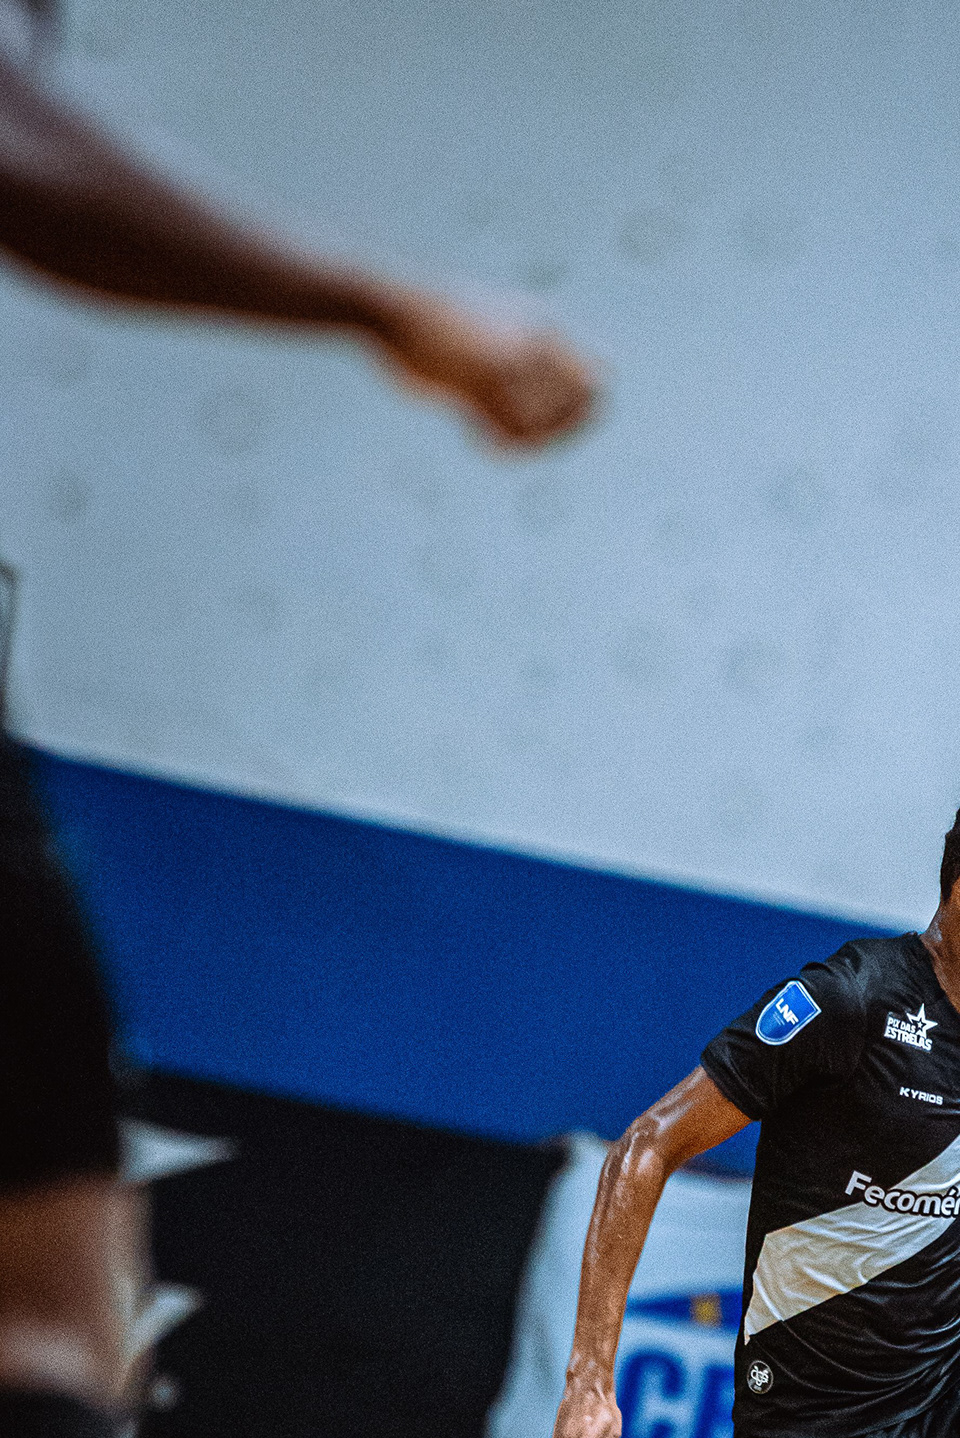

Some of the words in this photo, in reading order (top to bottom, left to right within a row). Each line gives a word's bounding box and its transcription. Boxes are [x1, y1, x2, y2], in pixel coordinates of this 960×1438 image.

[776, 998, 799, 1025] LNF
[887, 1017, 900, 1029] PIX
[900, 1020, 916, 1034] DAS
[884, 1027, 933, 1052] ESTRELAS
[899, 1086, 944, 1106] KYRIOS
